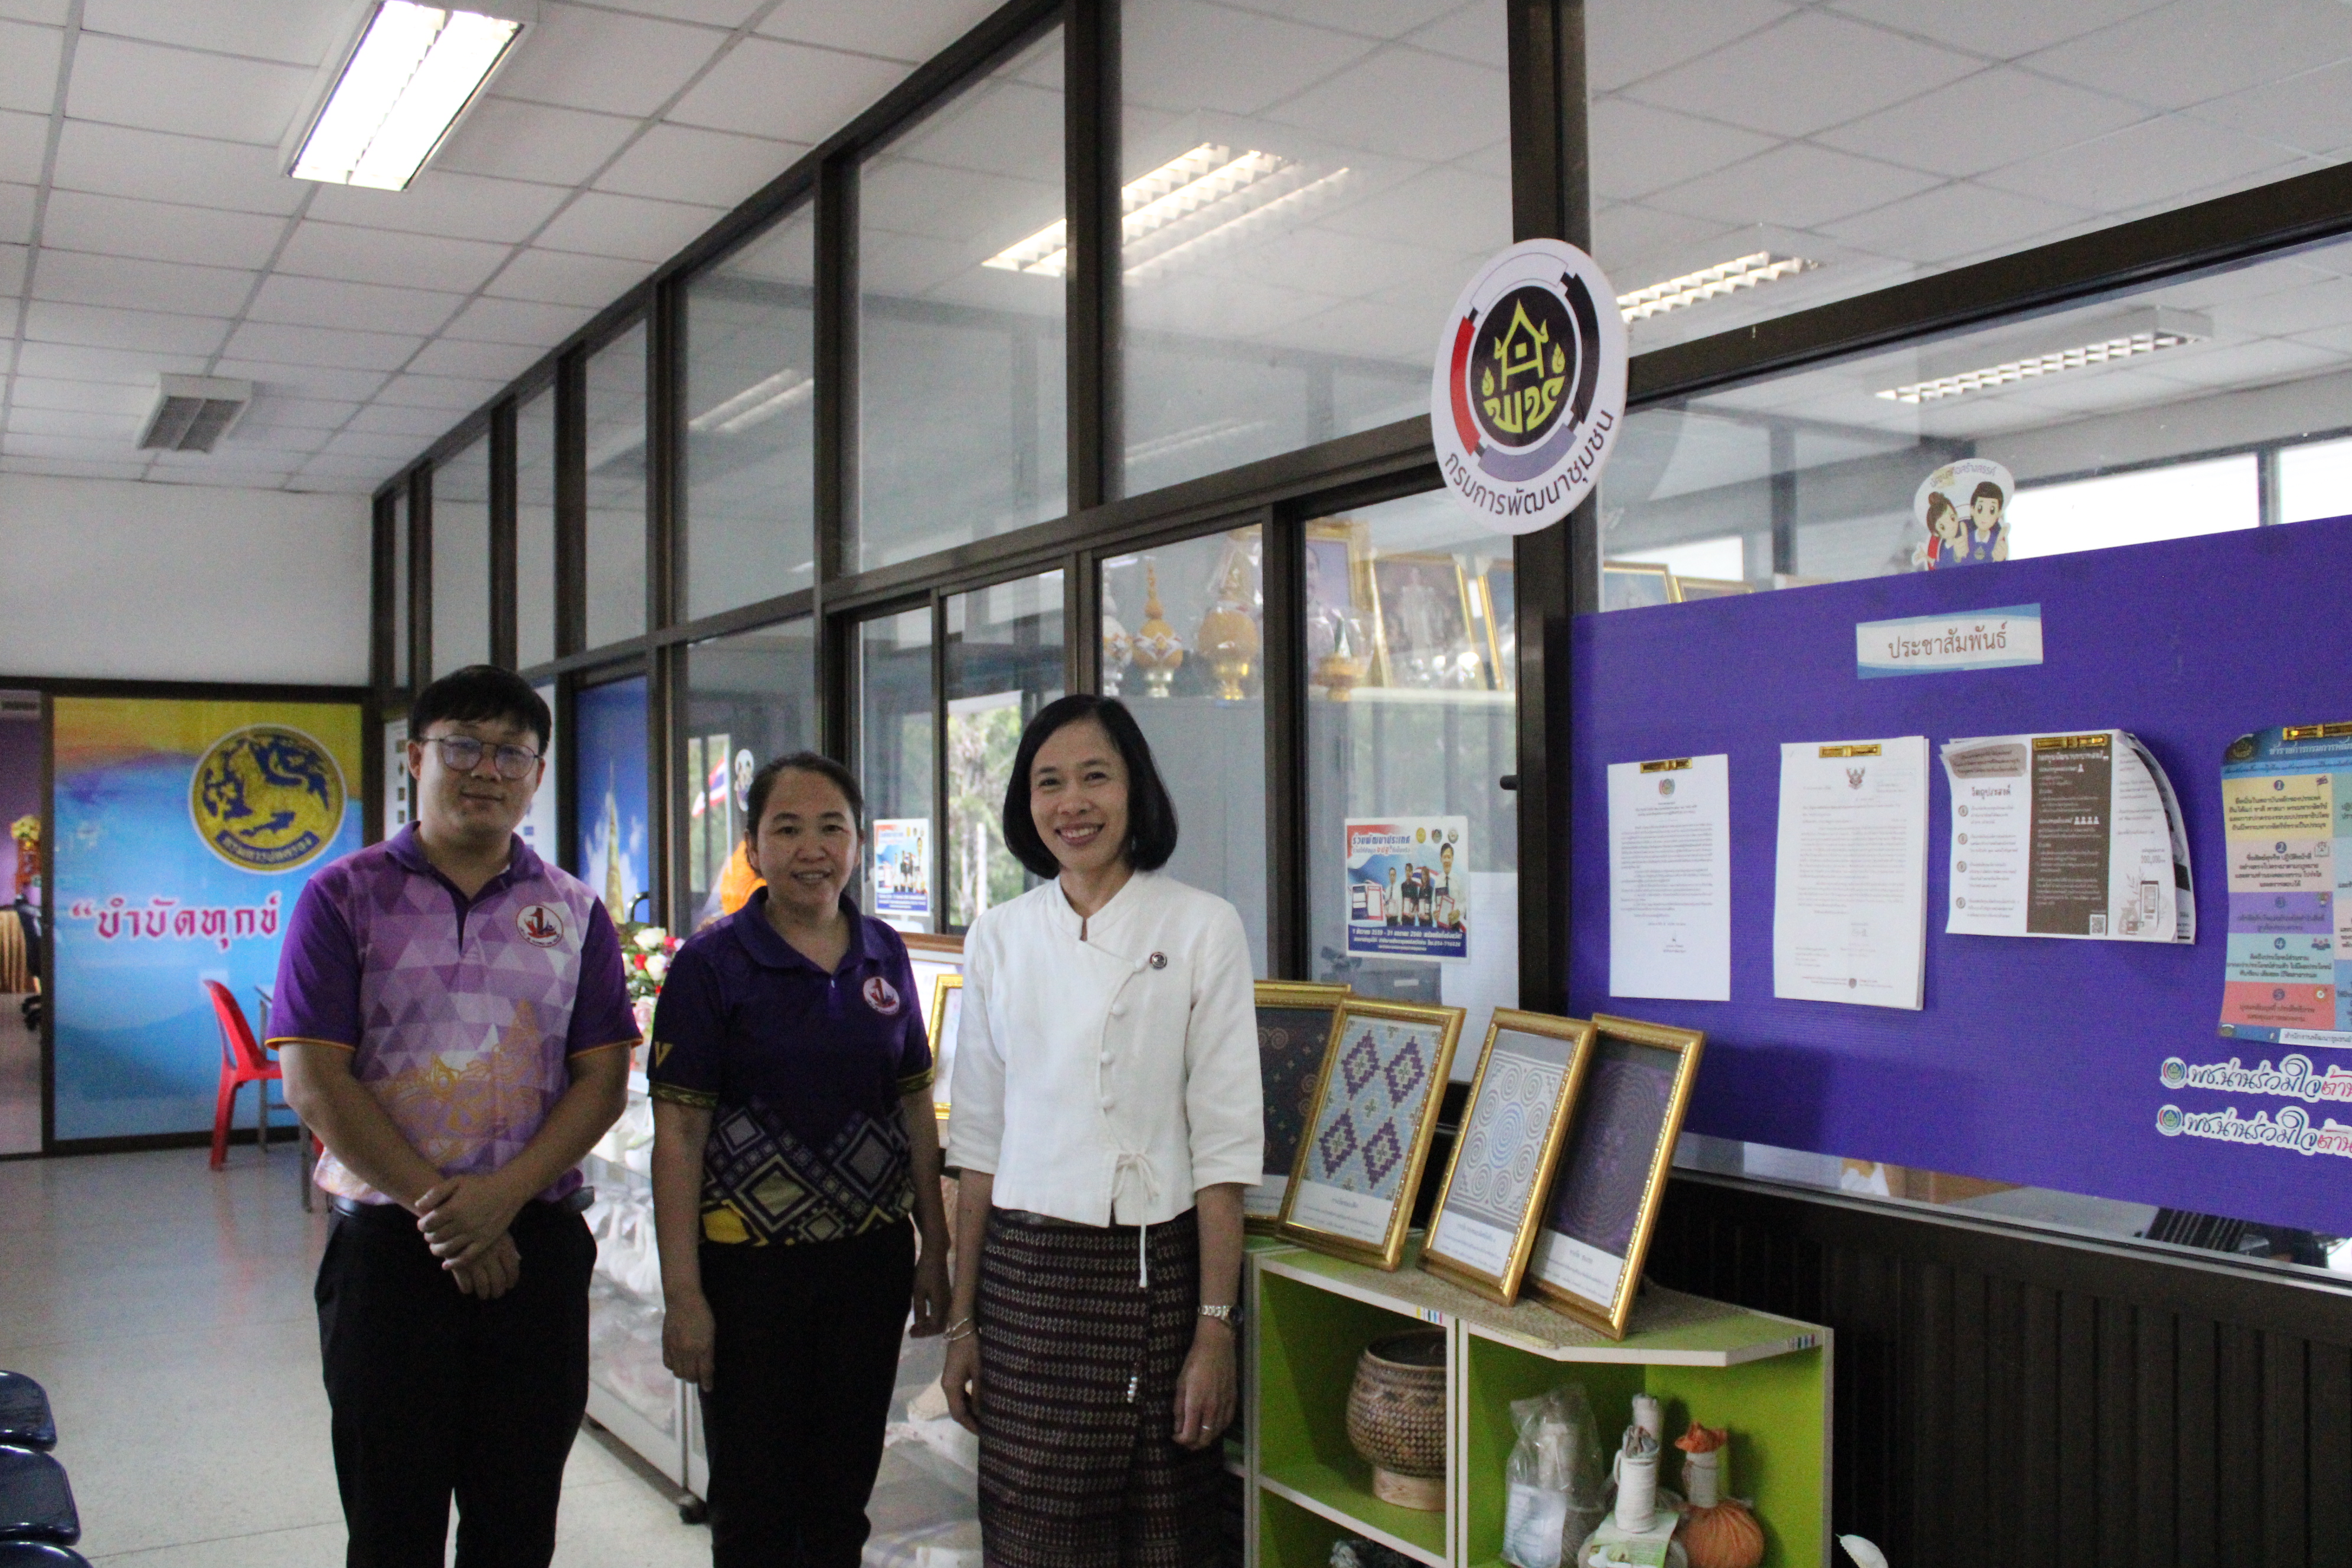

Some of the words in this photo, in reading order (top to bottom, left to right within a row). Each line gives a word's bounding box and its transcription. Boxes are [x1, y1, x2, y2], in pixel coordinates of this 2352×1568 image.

[1445, 409, 1613, 517] กรมการพัฒนาชุมชน
[1888, 621, 2008, 659] ประชาสัมพันธ์
[71, 894, 279, 950] “บำบัดทุกข์
